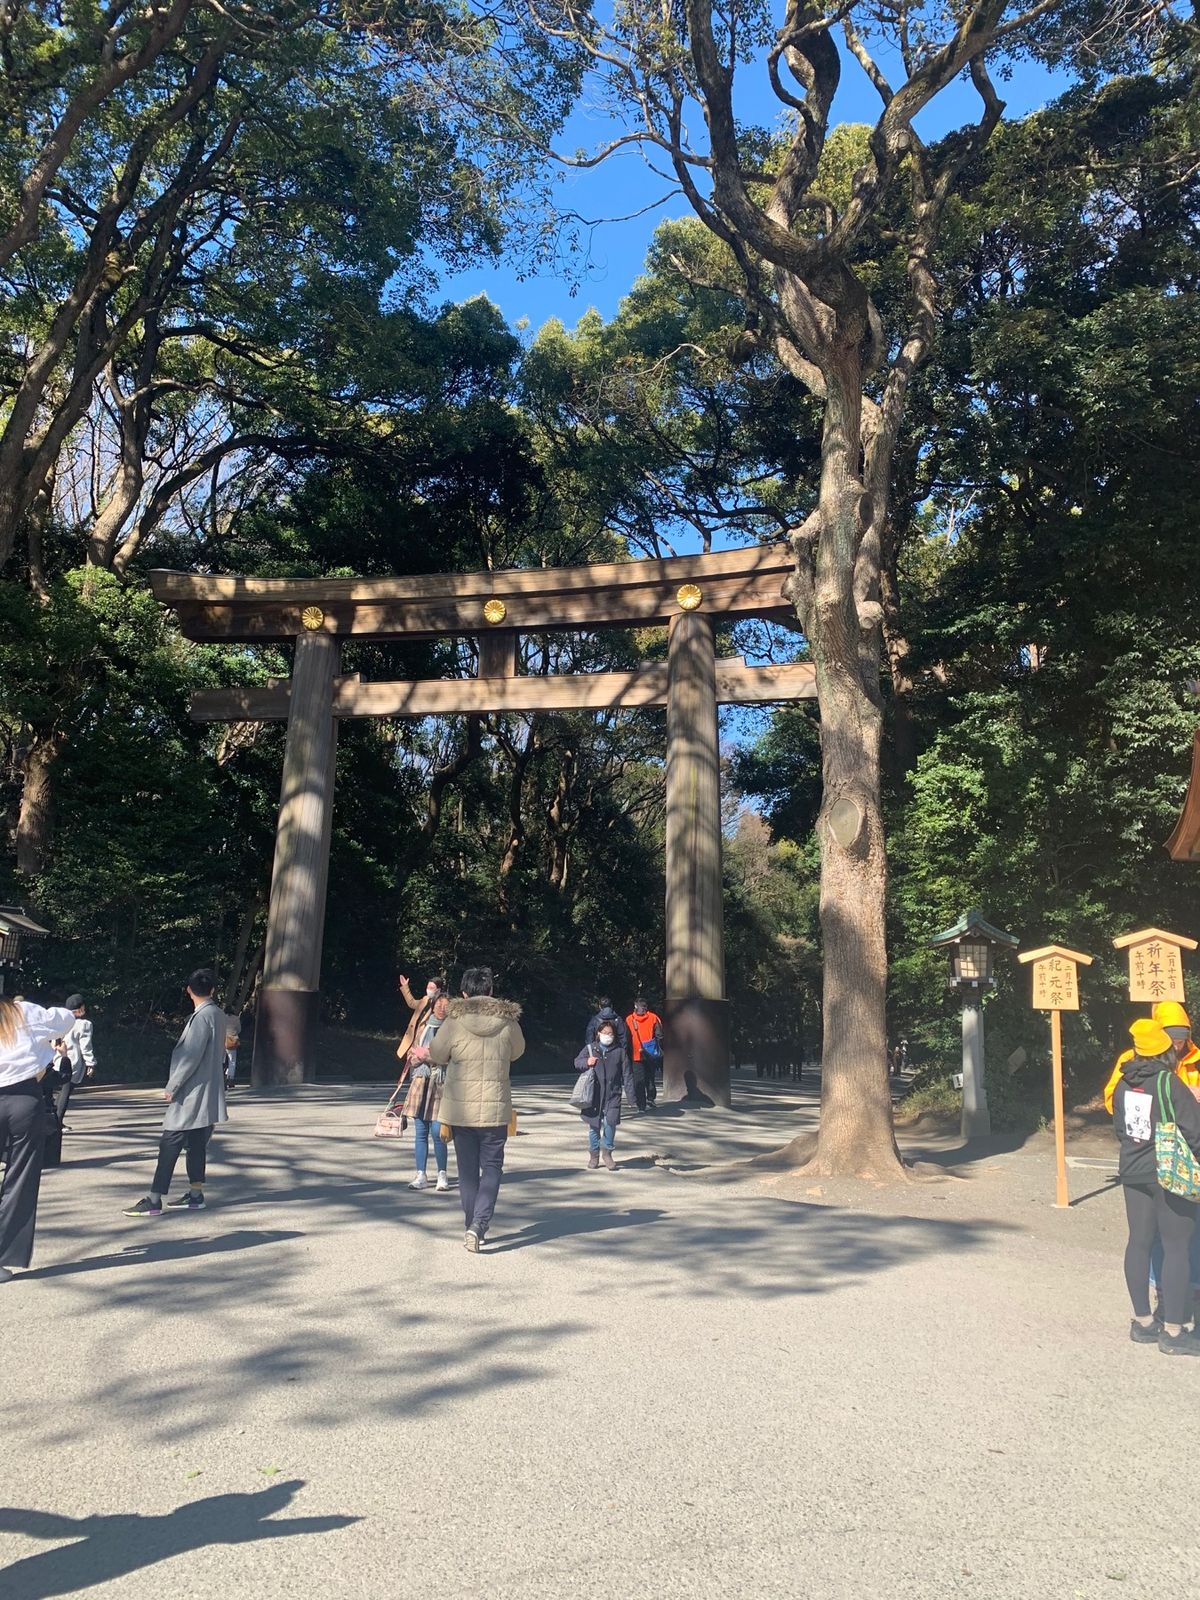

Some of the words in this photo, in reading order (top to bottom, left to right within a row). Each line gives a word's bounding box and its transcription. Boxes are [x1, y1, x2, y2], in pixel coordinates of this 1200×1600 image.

[1049, 959, 1063, 1005] 紀元祭
[1135, 951, 1145, 989] 午前十時
[1147, 943, 1166, 996] 祈年祭
[1167, 952, 1176, 989] 二月十七日
